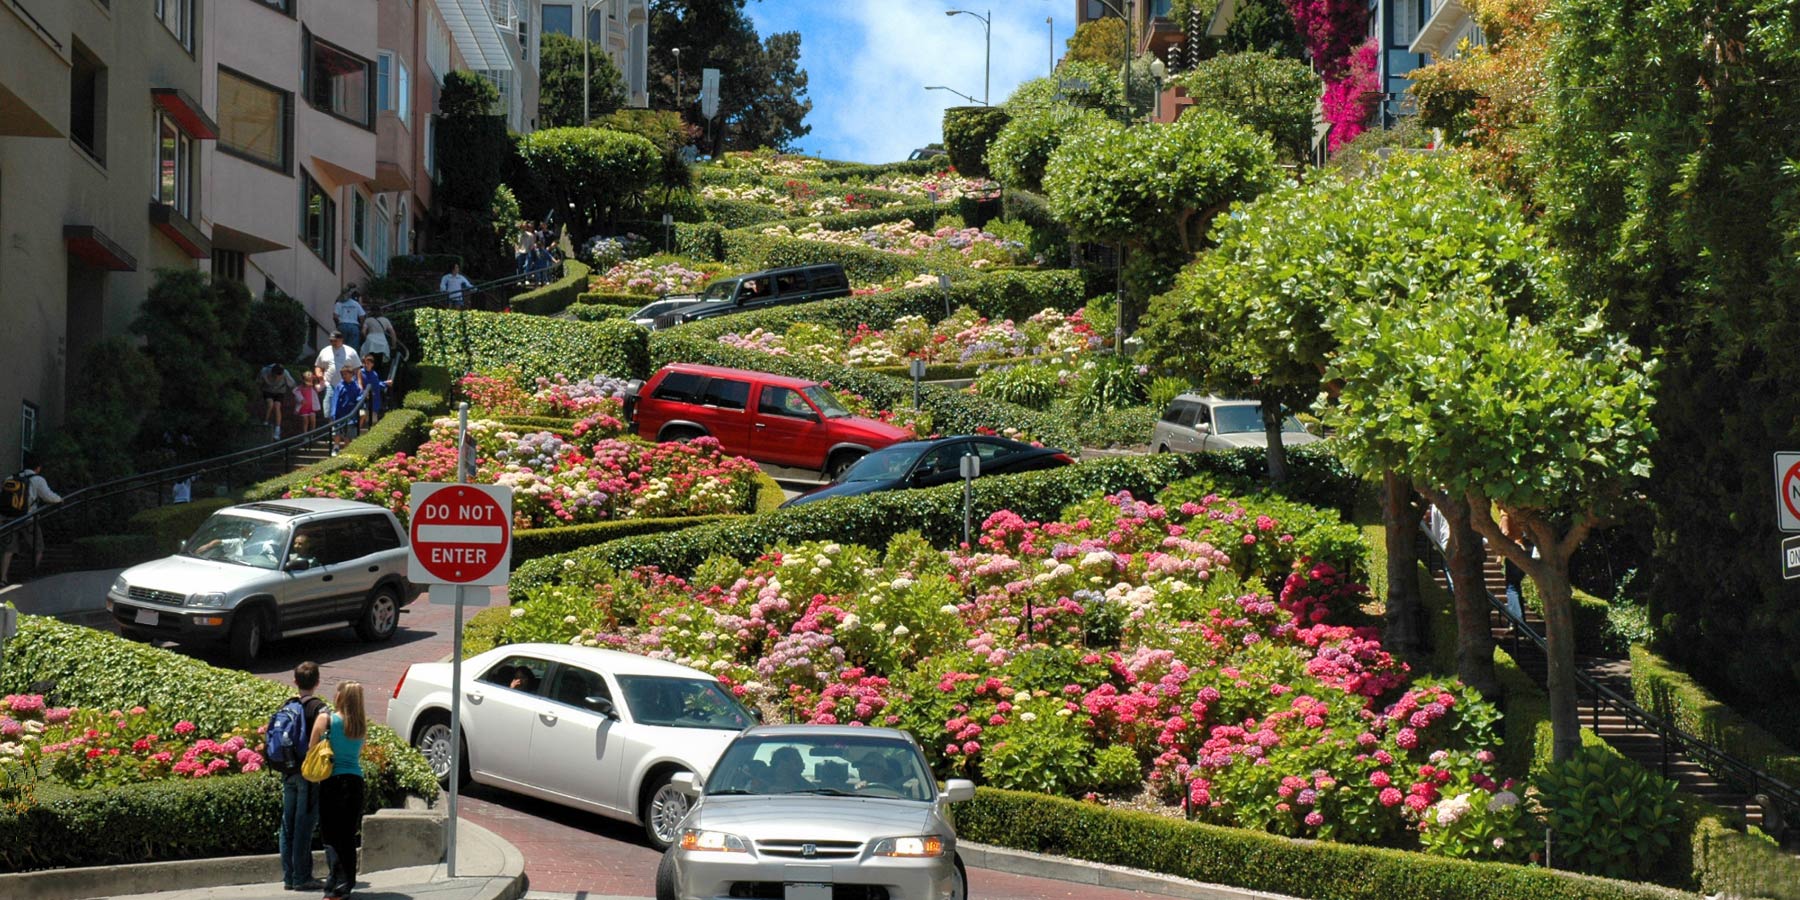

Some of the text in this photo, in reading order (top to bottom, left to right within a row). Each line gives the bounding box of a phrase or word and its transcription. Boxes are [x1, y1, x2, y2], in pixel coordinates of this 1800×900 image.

[426, 504, 494, 520] DO NOT
[431, 548, 487, 564] ENTER
